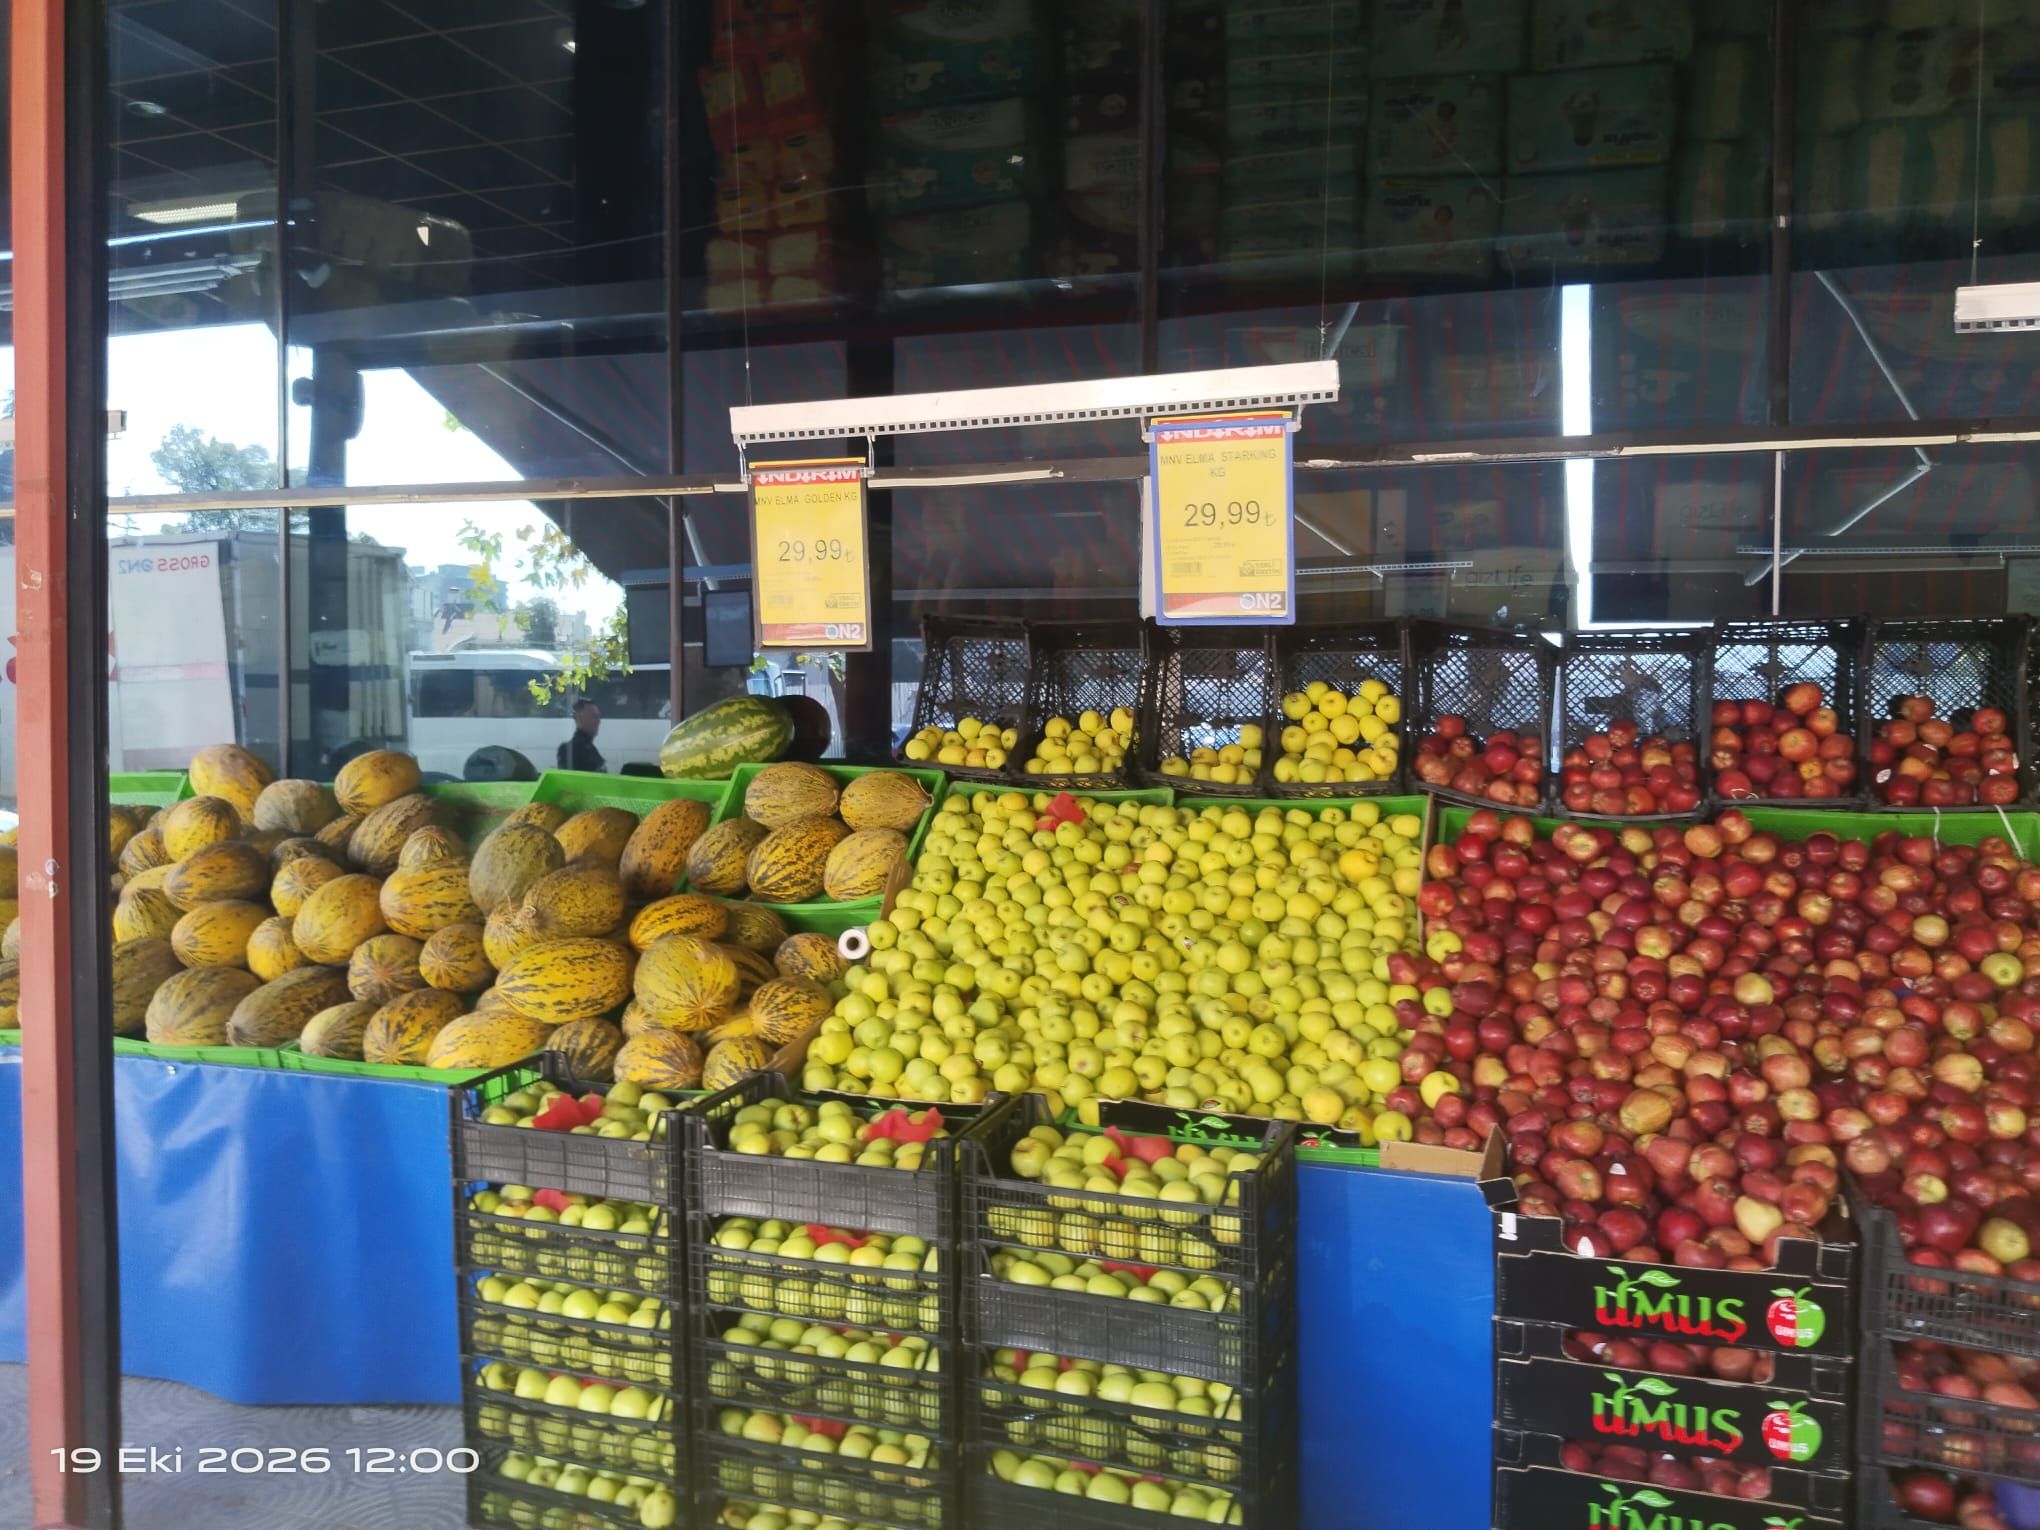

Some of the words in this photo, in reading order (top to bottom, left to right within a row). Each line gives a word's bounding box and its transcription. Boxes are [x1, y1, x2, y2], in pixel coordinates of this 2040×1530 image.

[1186, 453, 1215, 464] ELMA
[1210, 467, 1226, 478] KG
[775, 495, 799, 505] ELMA
[805, 493, 842, 504] GOLDEN
[844, 491, 857, 501] KG
